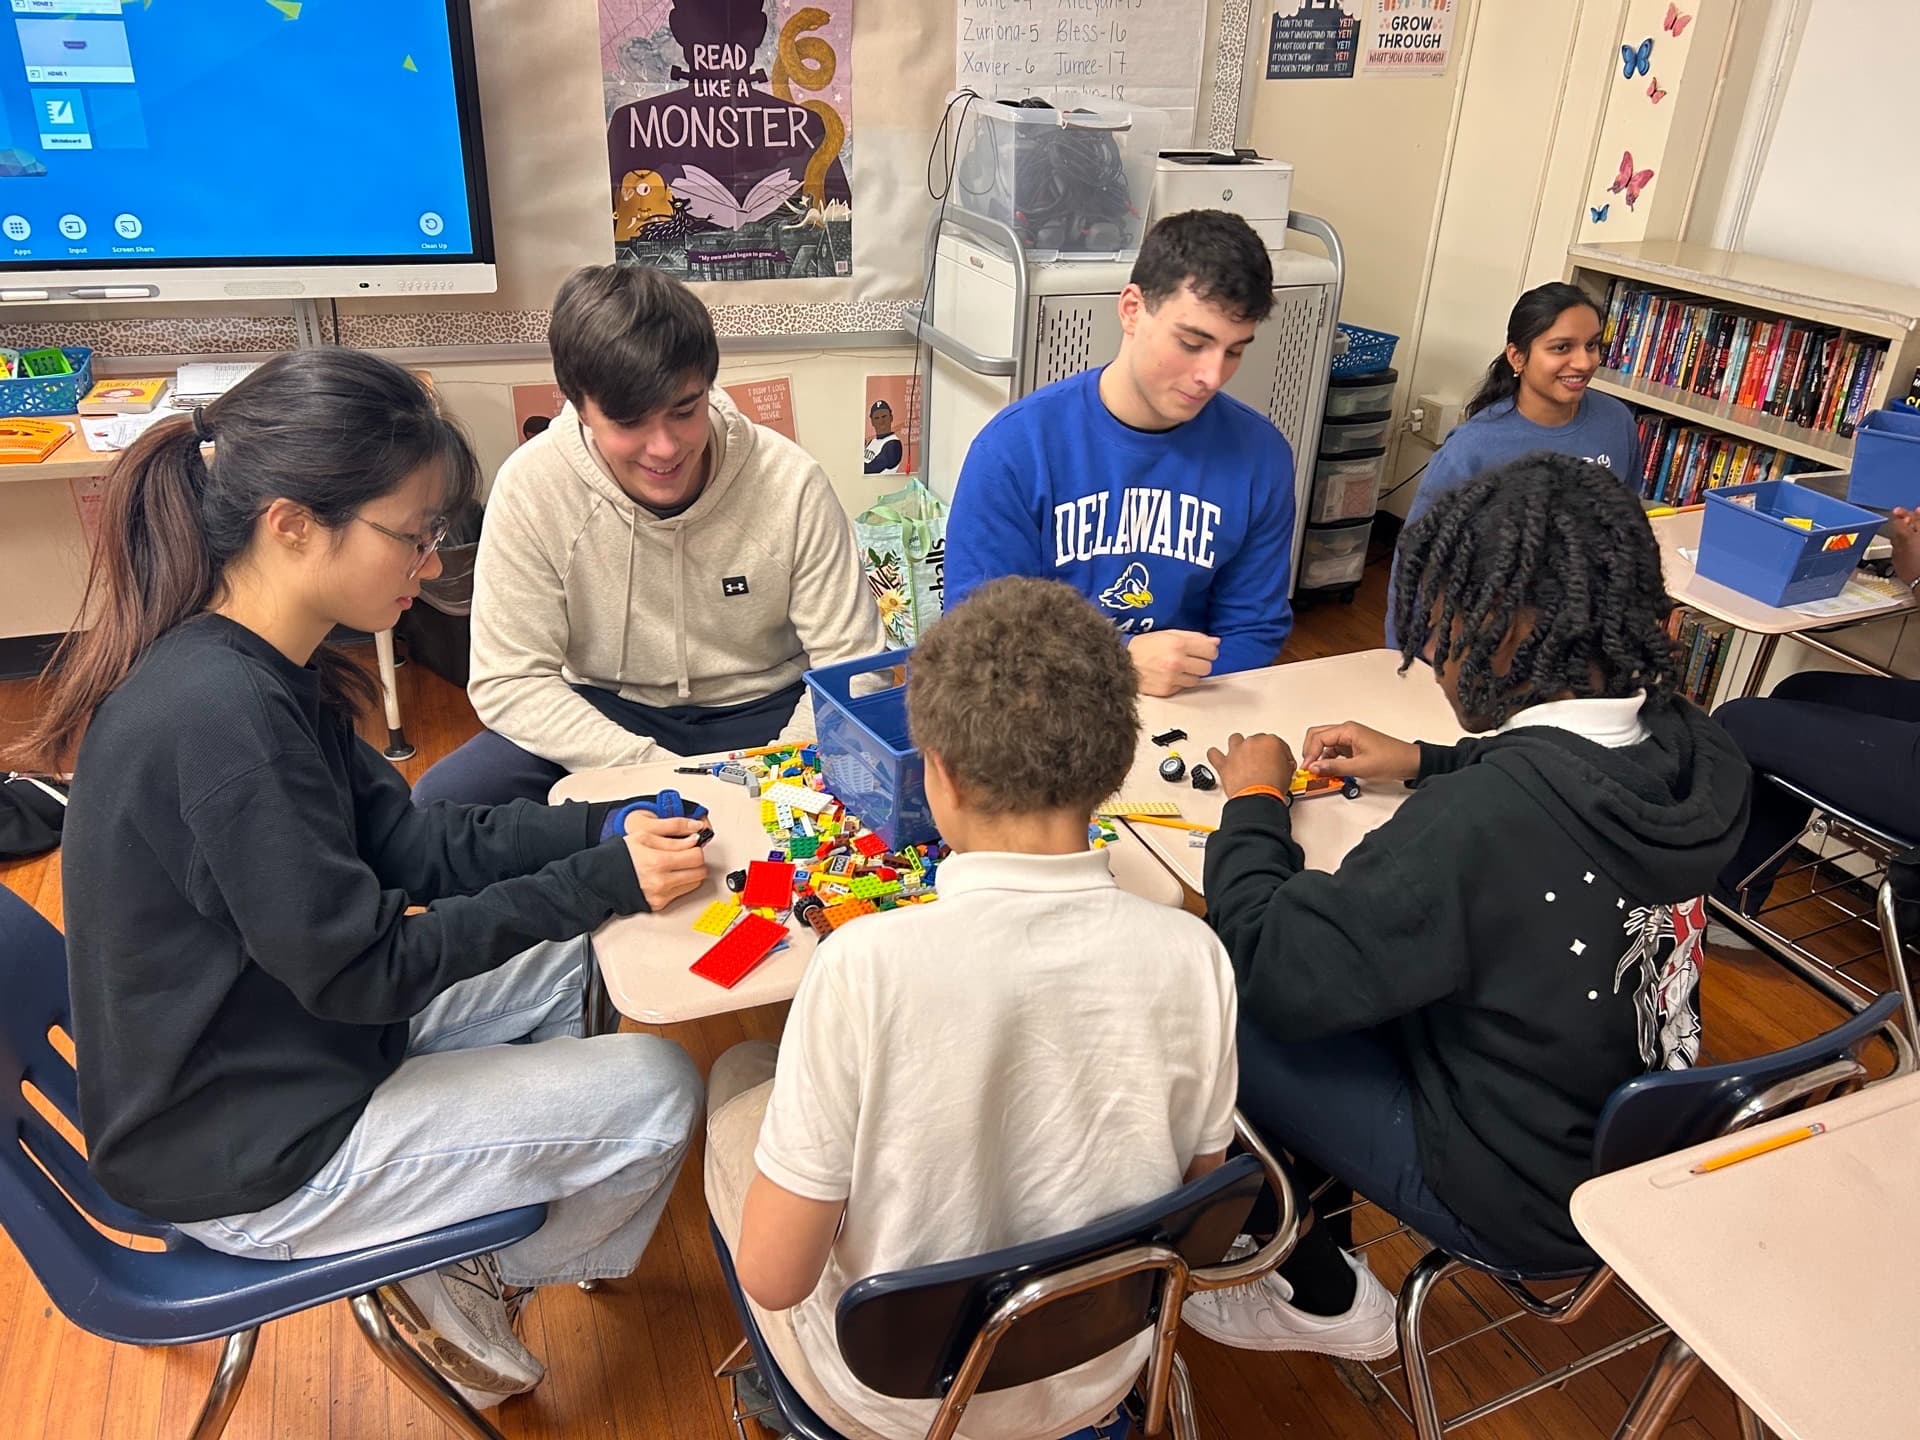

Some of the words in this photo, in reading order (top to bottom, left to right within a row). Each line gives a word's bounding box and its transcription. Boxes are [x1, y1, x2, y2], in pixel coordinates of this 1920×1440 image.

[1391, 15, 1433, 31] GROW
[1378, 33, 1442, 48] THROUGH
[693, 43, 747, 70] READ
[963, 51, 1010, 76] Xavier
[1369, 52, 1389, 64] WHAT
[1389, 52, 1403, 63] YOU
[1404, 52, 1414, 63] GO
[1416, 52, 1445, 63] THROUGH
[694, 79, 731, 98] LIKE
[737, 79, 749, 98] A
[629, 104, 815, 149] MONSTER
[1054, 487, 1222, 569] DELAWARE
